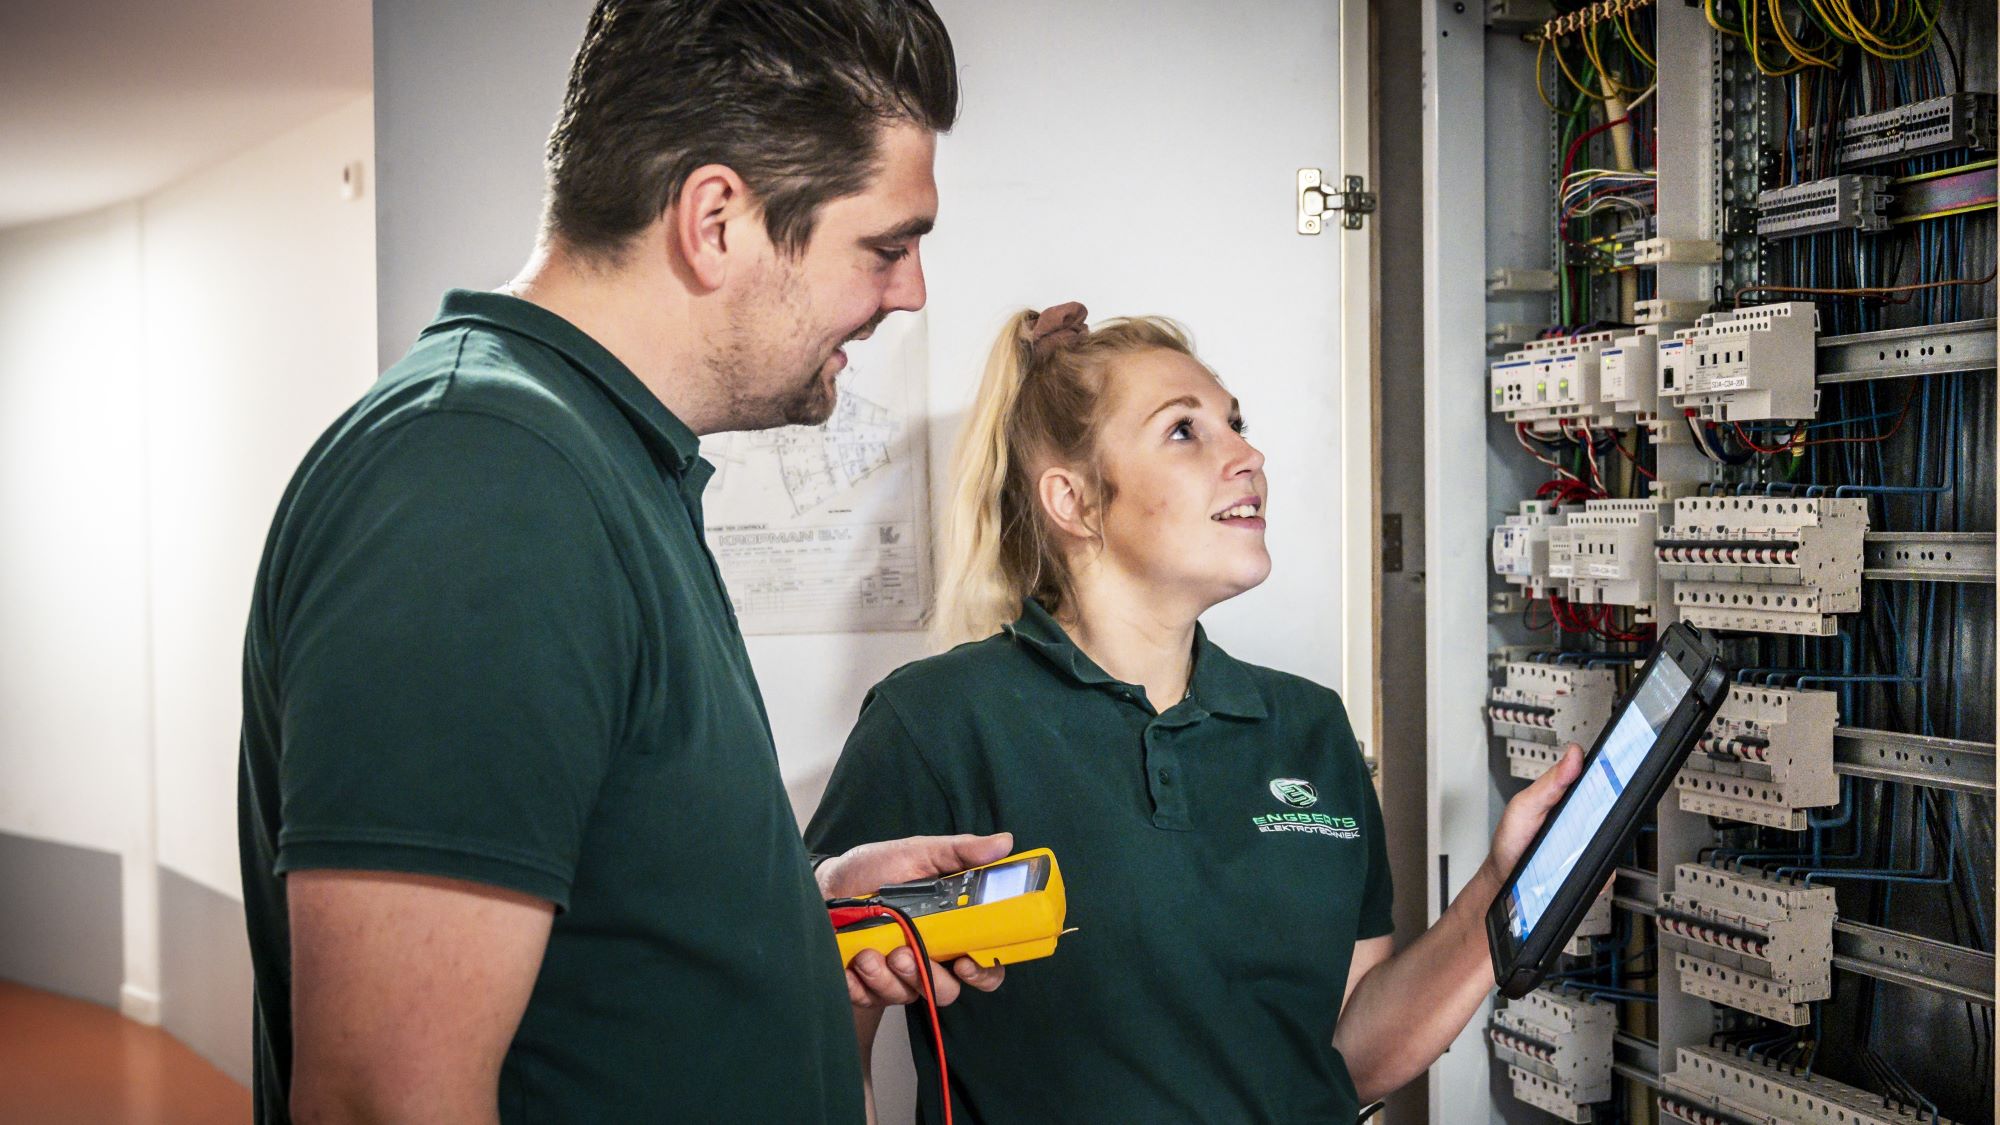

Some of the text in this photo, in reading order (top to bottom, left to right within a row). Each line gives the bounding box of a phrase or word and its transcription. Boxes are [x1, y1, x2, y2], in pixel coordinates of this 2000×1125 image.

[718, 530, 814, 546] KROPMAN
[1252, 813, 1356, 828] ENGBERTS
[1259, 825, 1360, 838] ELEKTROTECHNIEK
